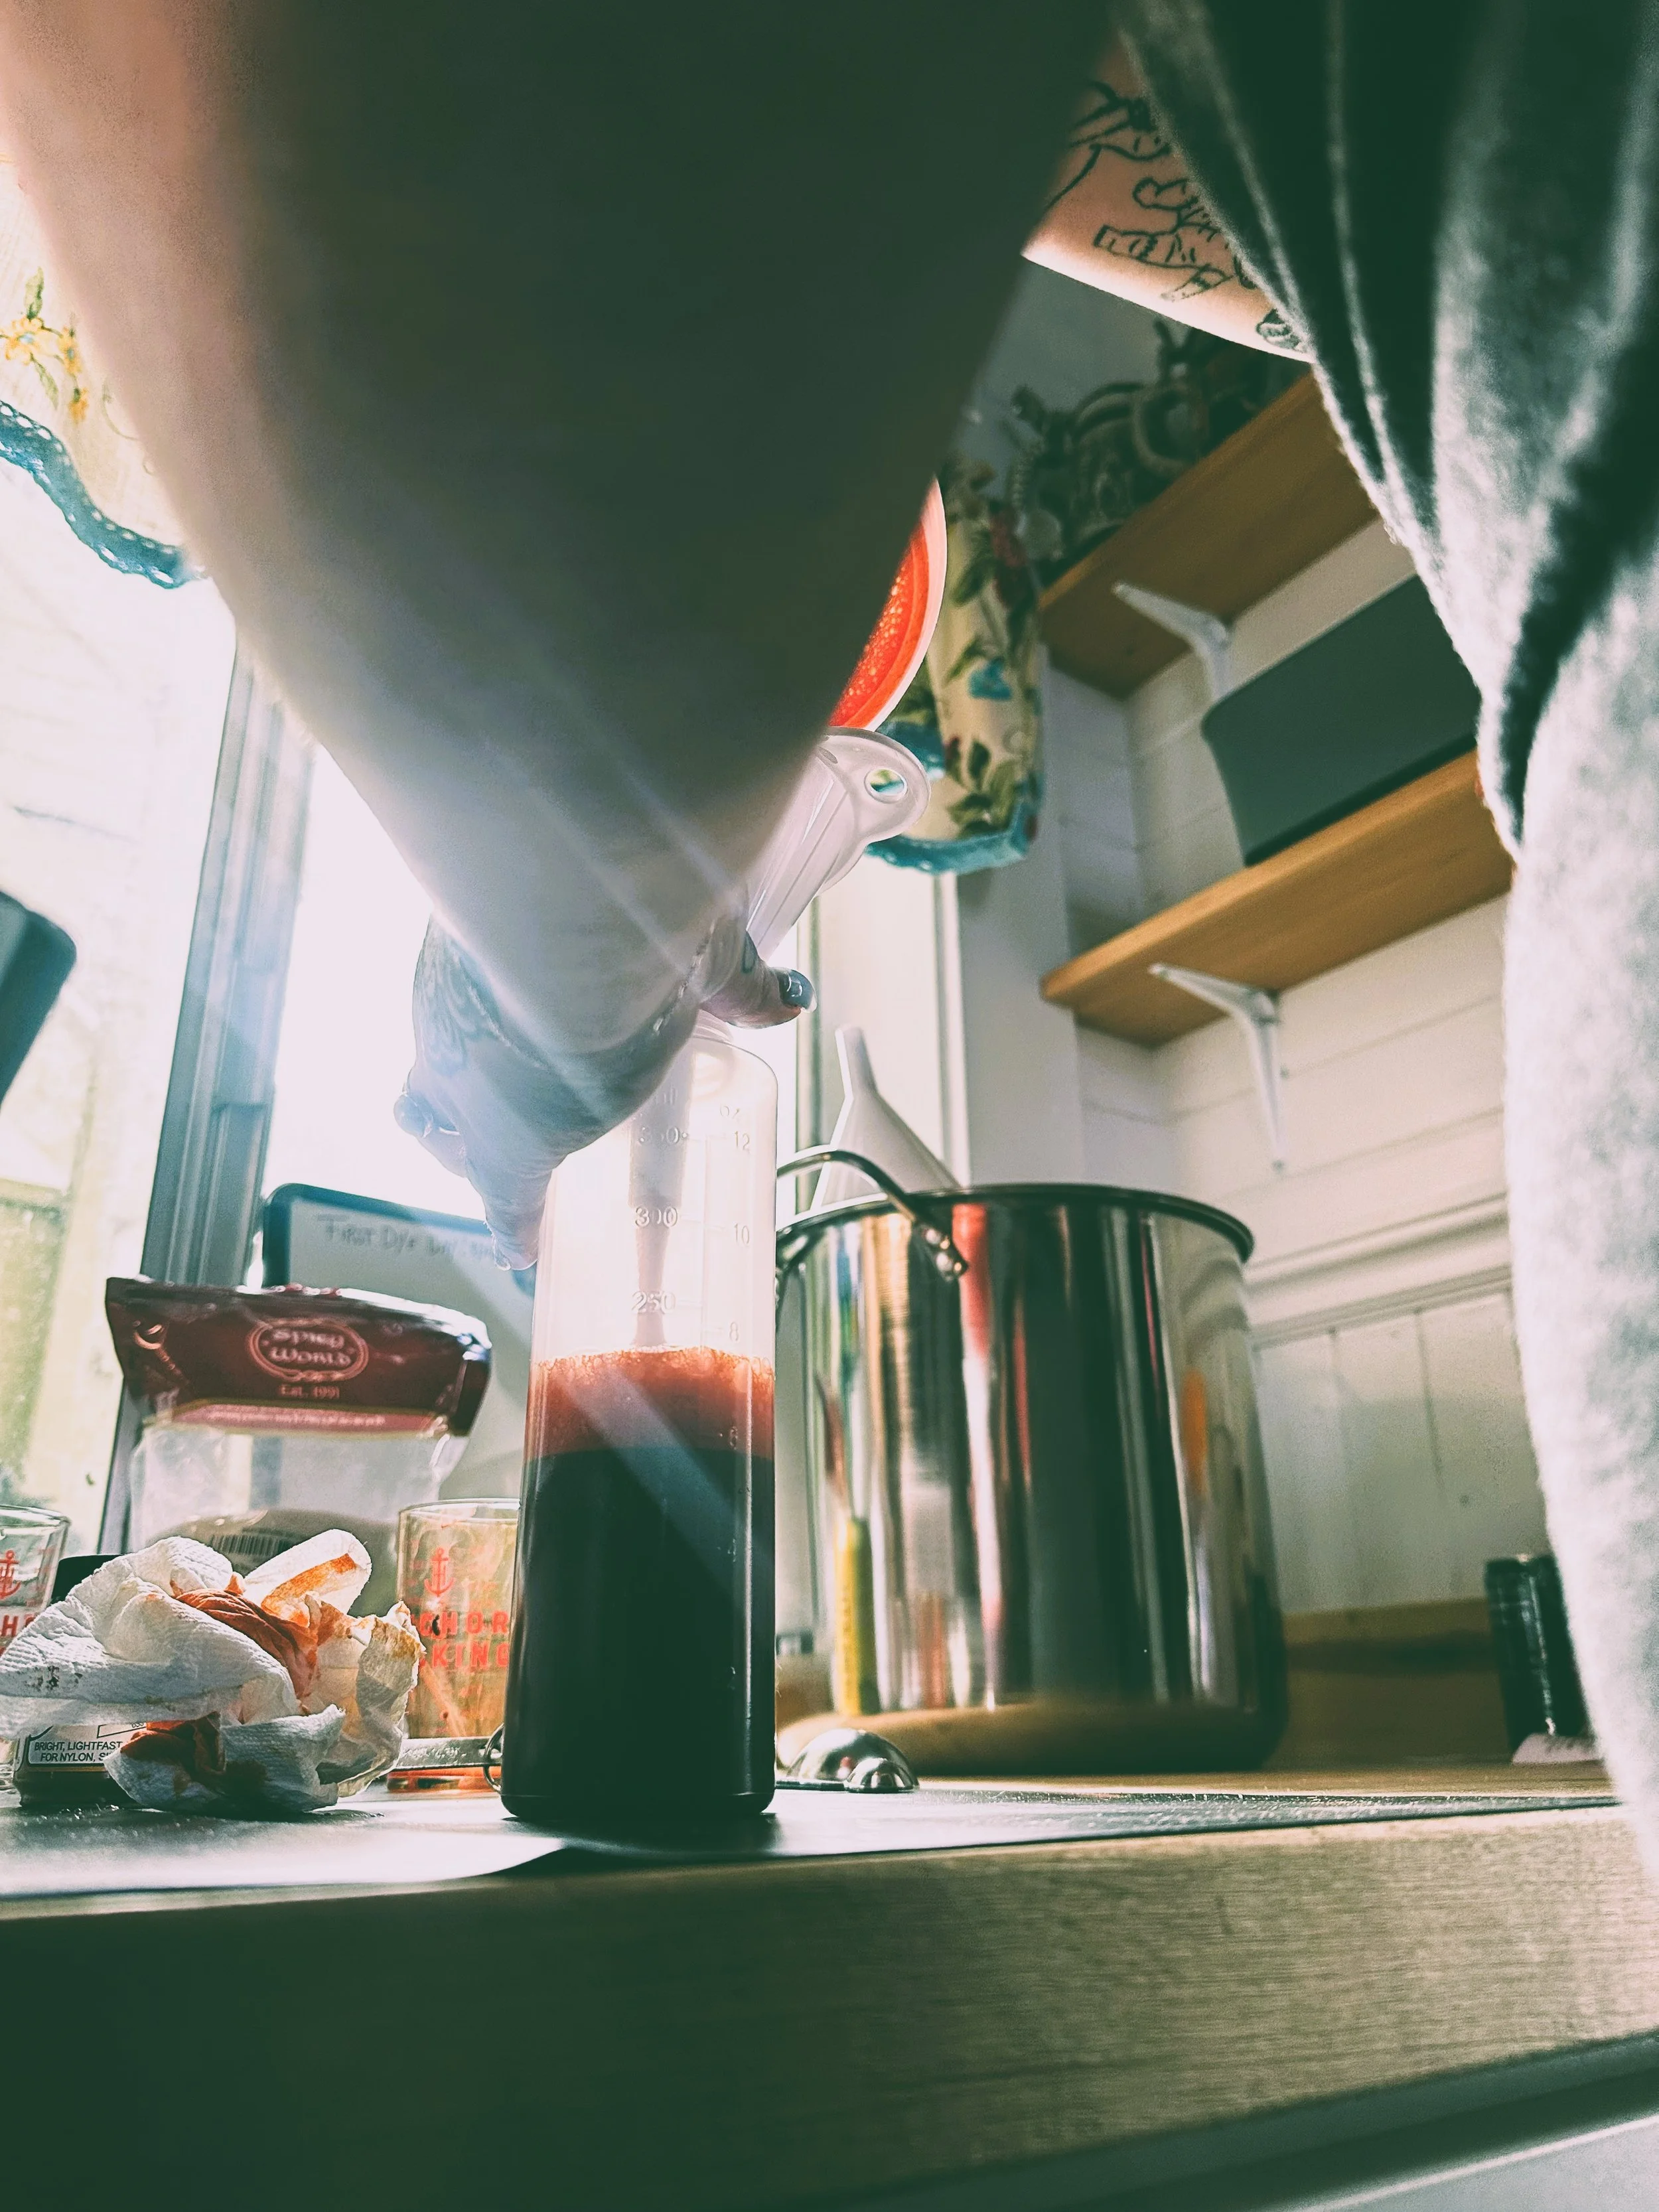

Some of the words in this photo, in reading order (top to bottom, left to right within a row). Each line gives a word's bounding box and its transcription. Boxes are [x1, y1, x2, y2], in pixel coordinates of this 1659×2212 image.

[734, 1130, 751, 1154] 12
[635, 1206, 678, 1228] 300
[734, 1222, 750, 1246] 10
[631, 1290, 676, 1314] 250
[729, 1321, 739, 1342] 8
[411, 1611, 509, 1637] CHOR
[419, 1641, 509, 1668] KING
[35, 1741, 65, 1751] BRIGHT,
[67, 1741, 123, 1751] LIGHTFAST
[40, 1752, 58, 1762] FOR
[60, 1752, 96, 1763] NYLON,
